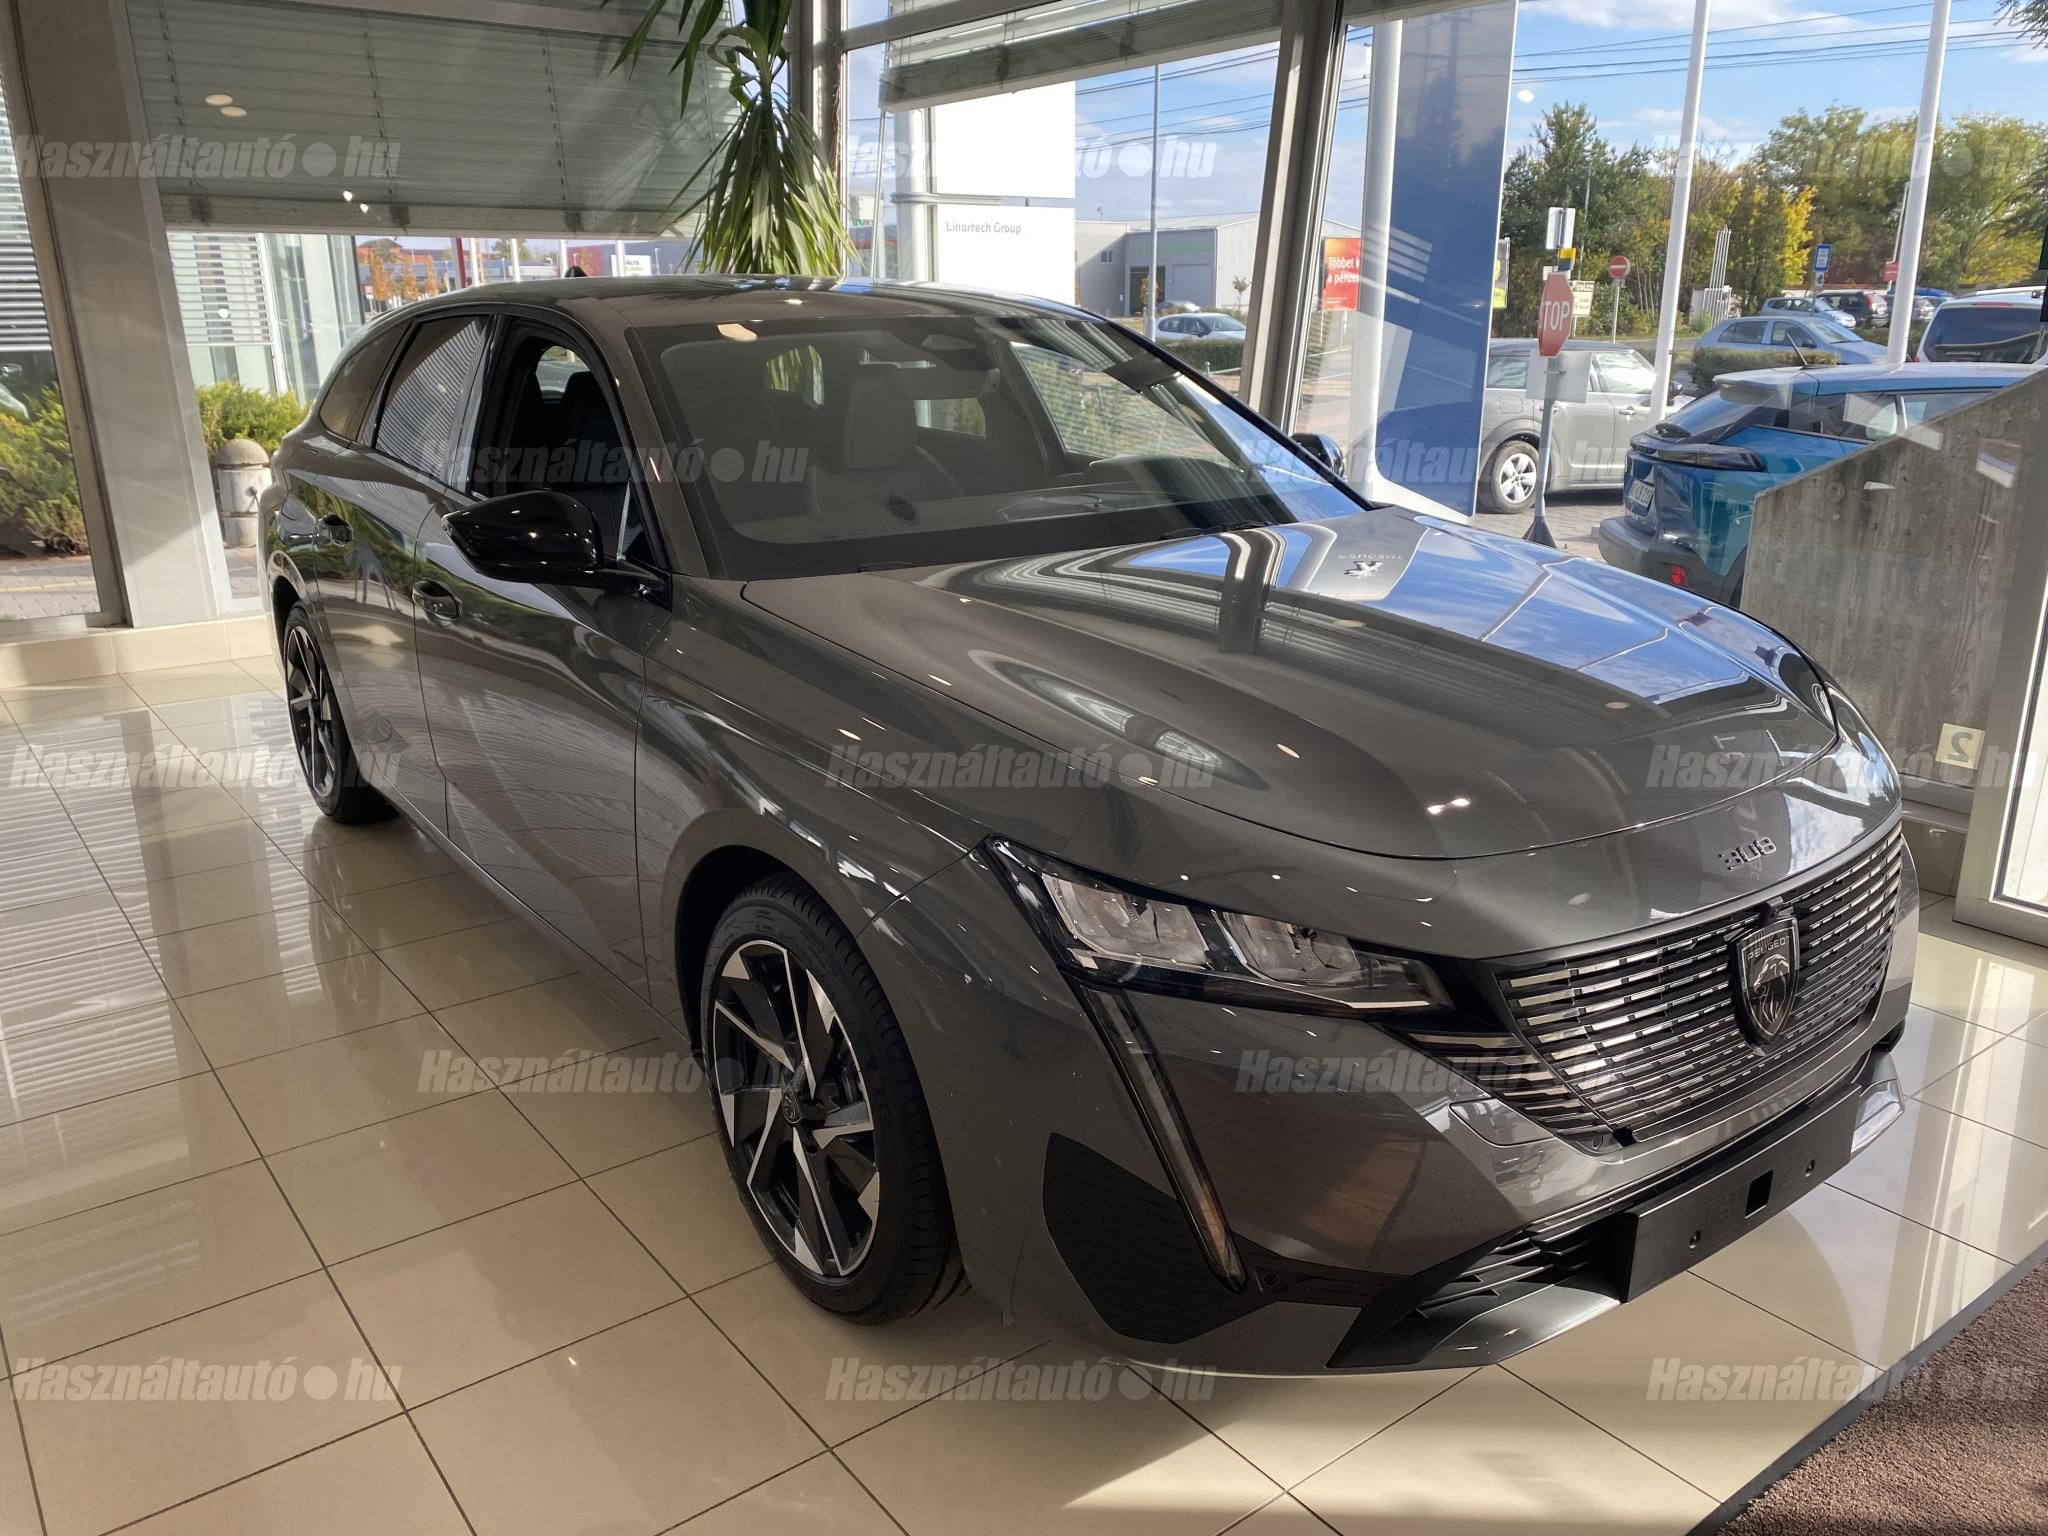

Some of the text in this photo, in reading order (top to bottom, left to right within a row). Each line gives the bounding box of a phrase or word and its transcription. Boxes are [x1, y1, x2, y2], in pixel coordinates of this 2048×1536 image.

[946, 220, 1022, 236] Linartech Group
[1539, 300, 1571, 331] STOP
[1718, 836, 1778, 871] 308
[1747, 935, 1791, 960] PEUGEOT
